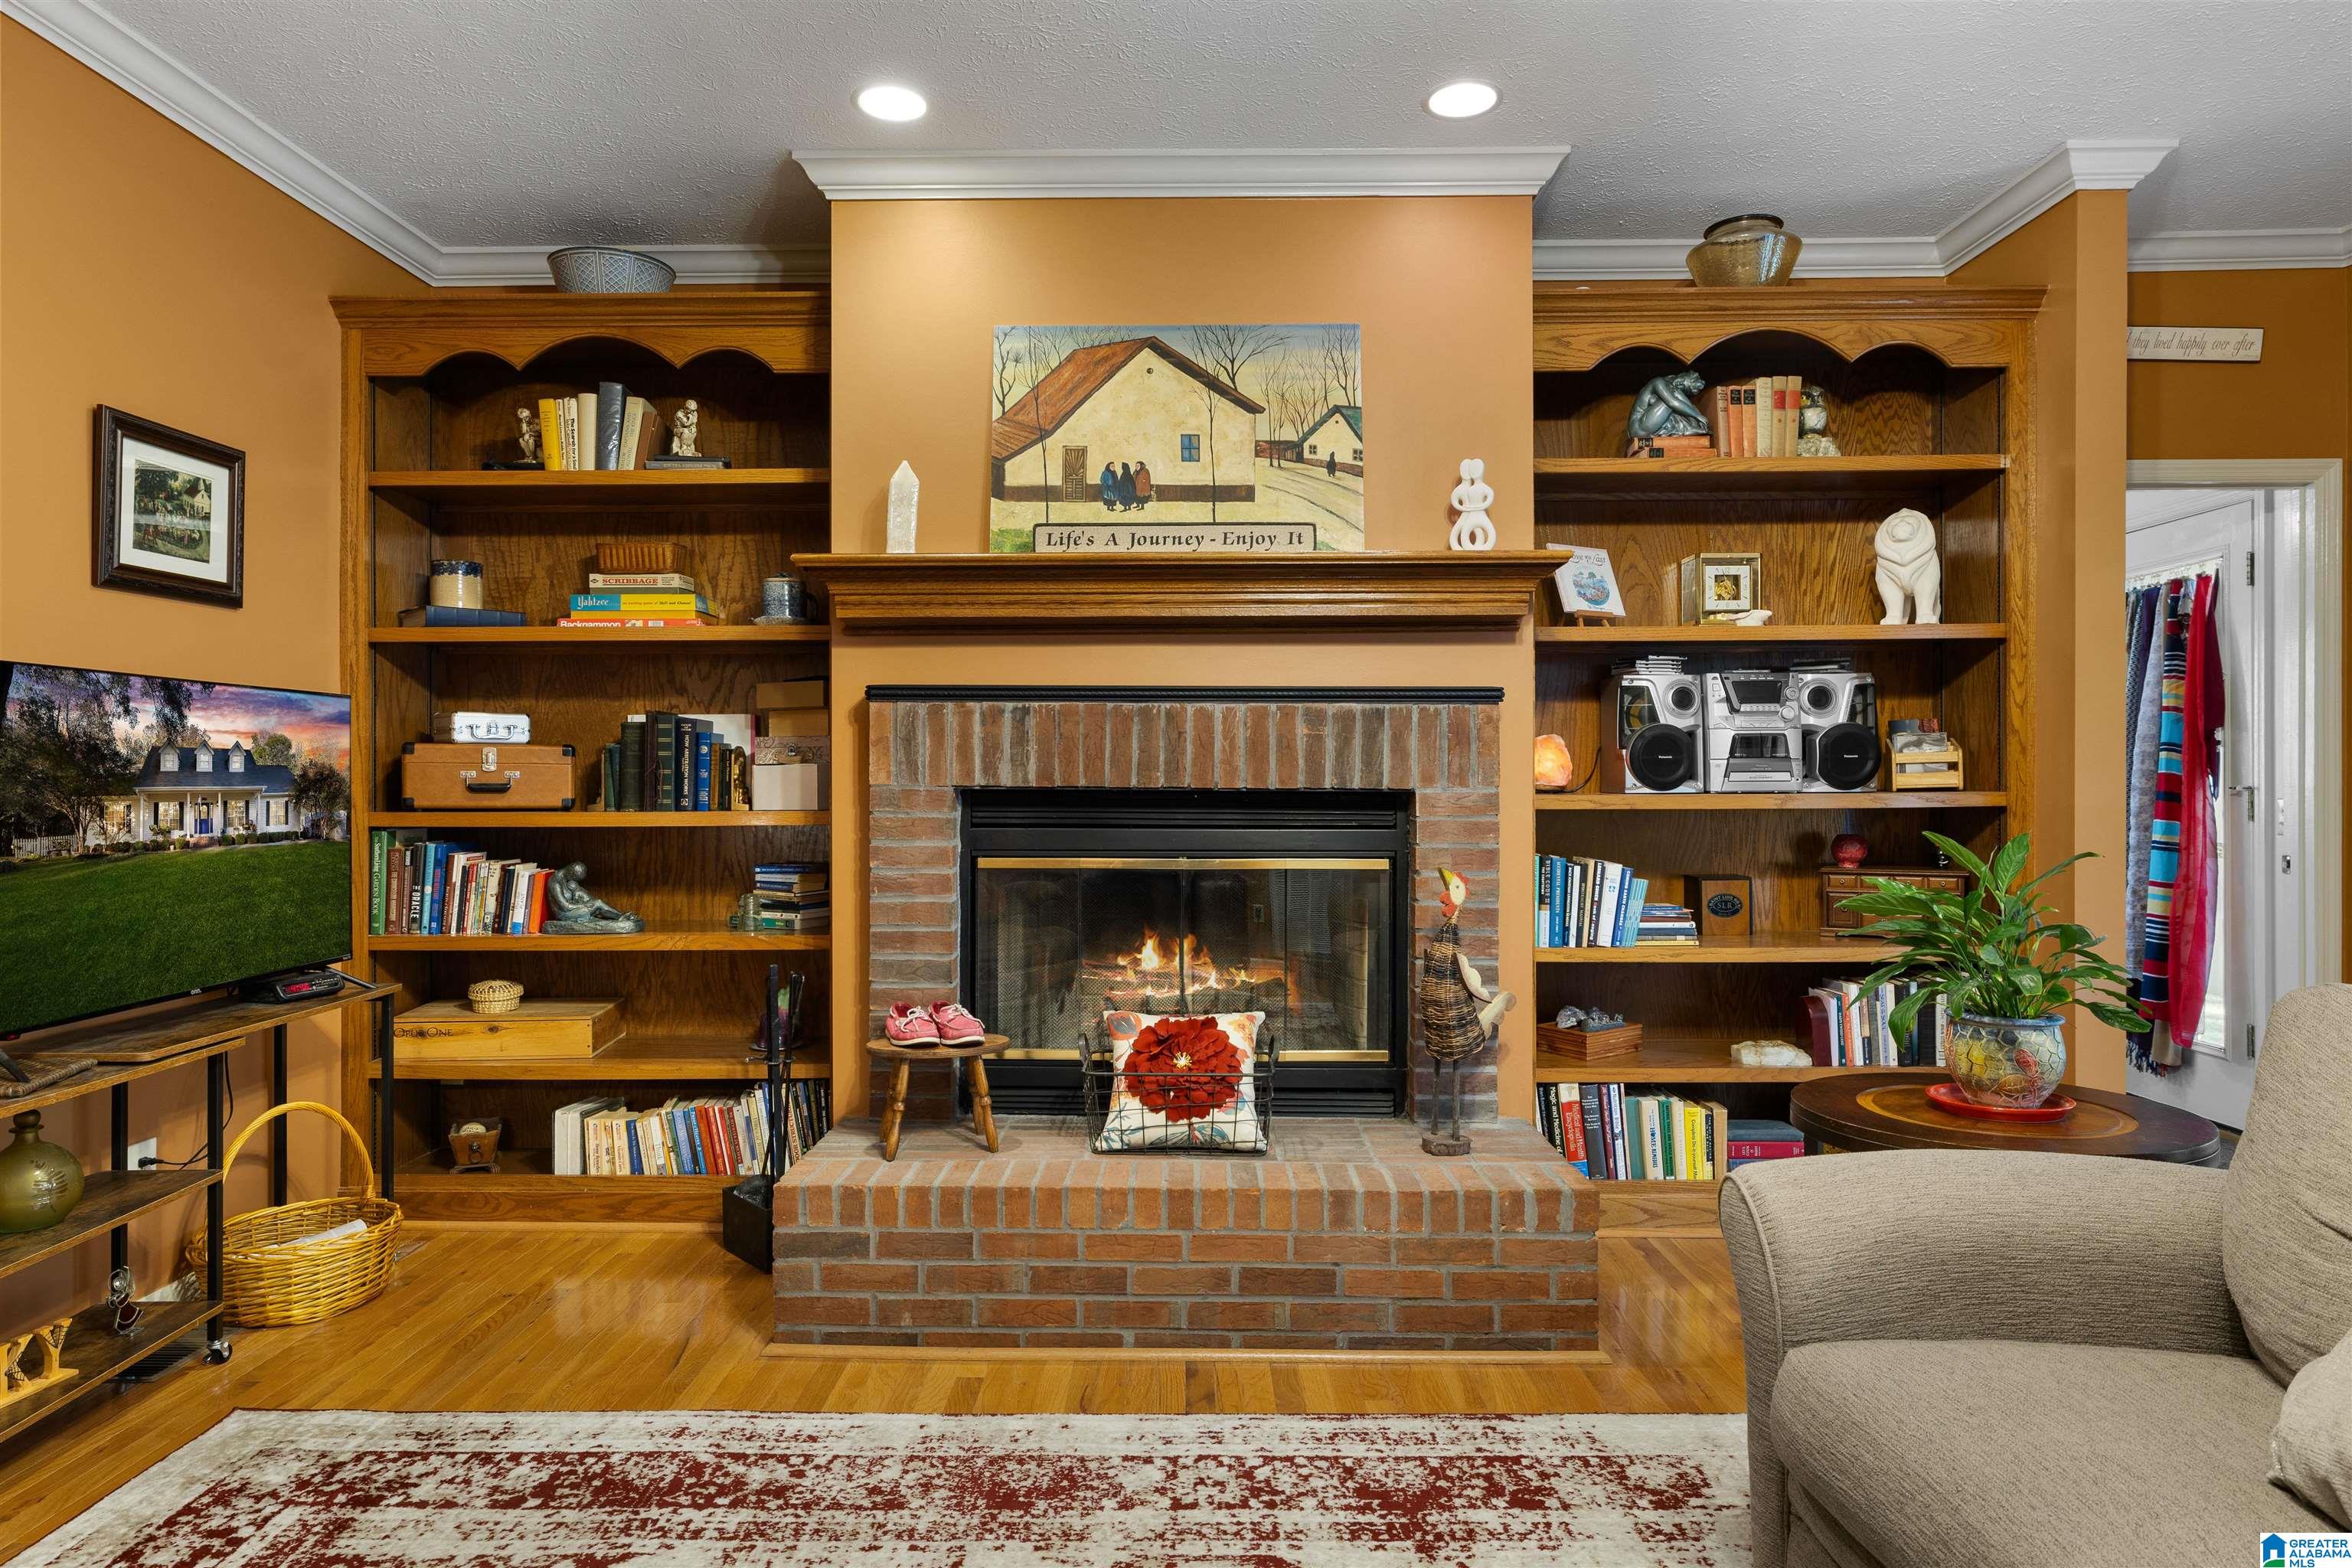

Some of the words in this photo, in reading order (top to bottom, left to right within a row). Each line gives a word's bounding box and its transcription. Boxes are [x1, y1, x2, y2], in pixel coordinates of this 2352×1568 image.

[2177, 331, 2207, 357] happily
[2232, 333, 2254, 356] after
[1046, 531, 1094, 551] Life's
[1105, 533, 1119, 546] A
[1127, 533, 1204, 551] Journey
[1222, 531, 1276, 550] Enjoy
[1287, 531, 1303, 545] It
[577, 595, 609, 609] Yahtzee
[410, 892, 420, 918] ORACLE
[427, 1027, 453, 1037] ONE
[1566, 1112, 1576, 1152] Encyclopedia
